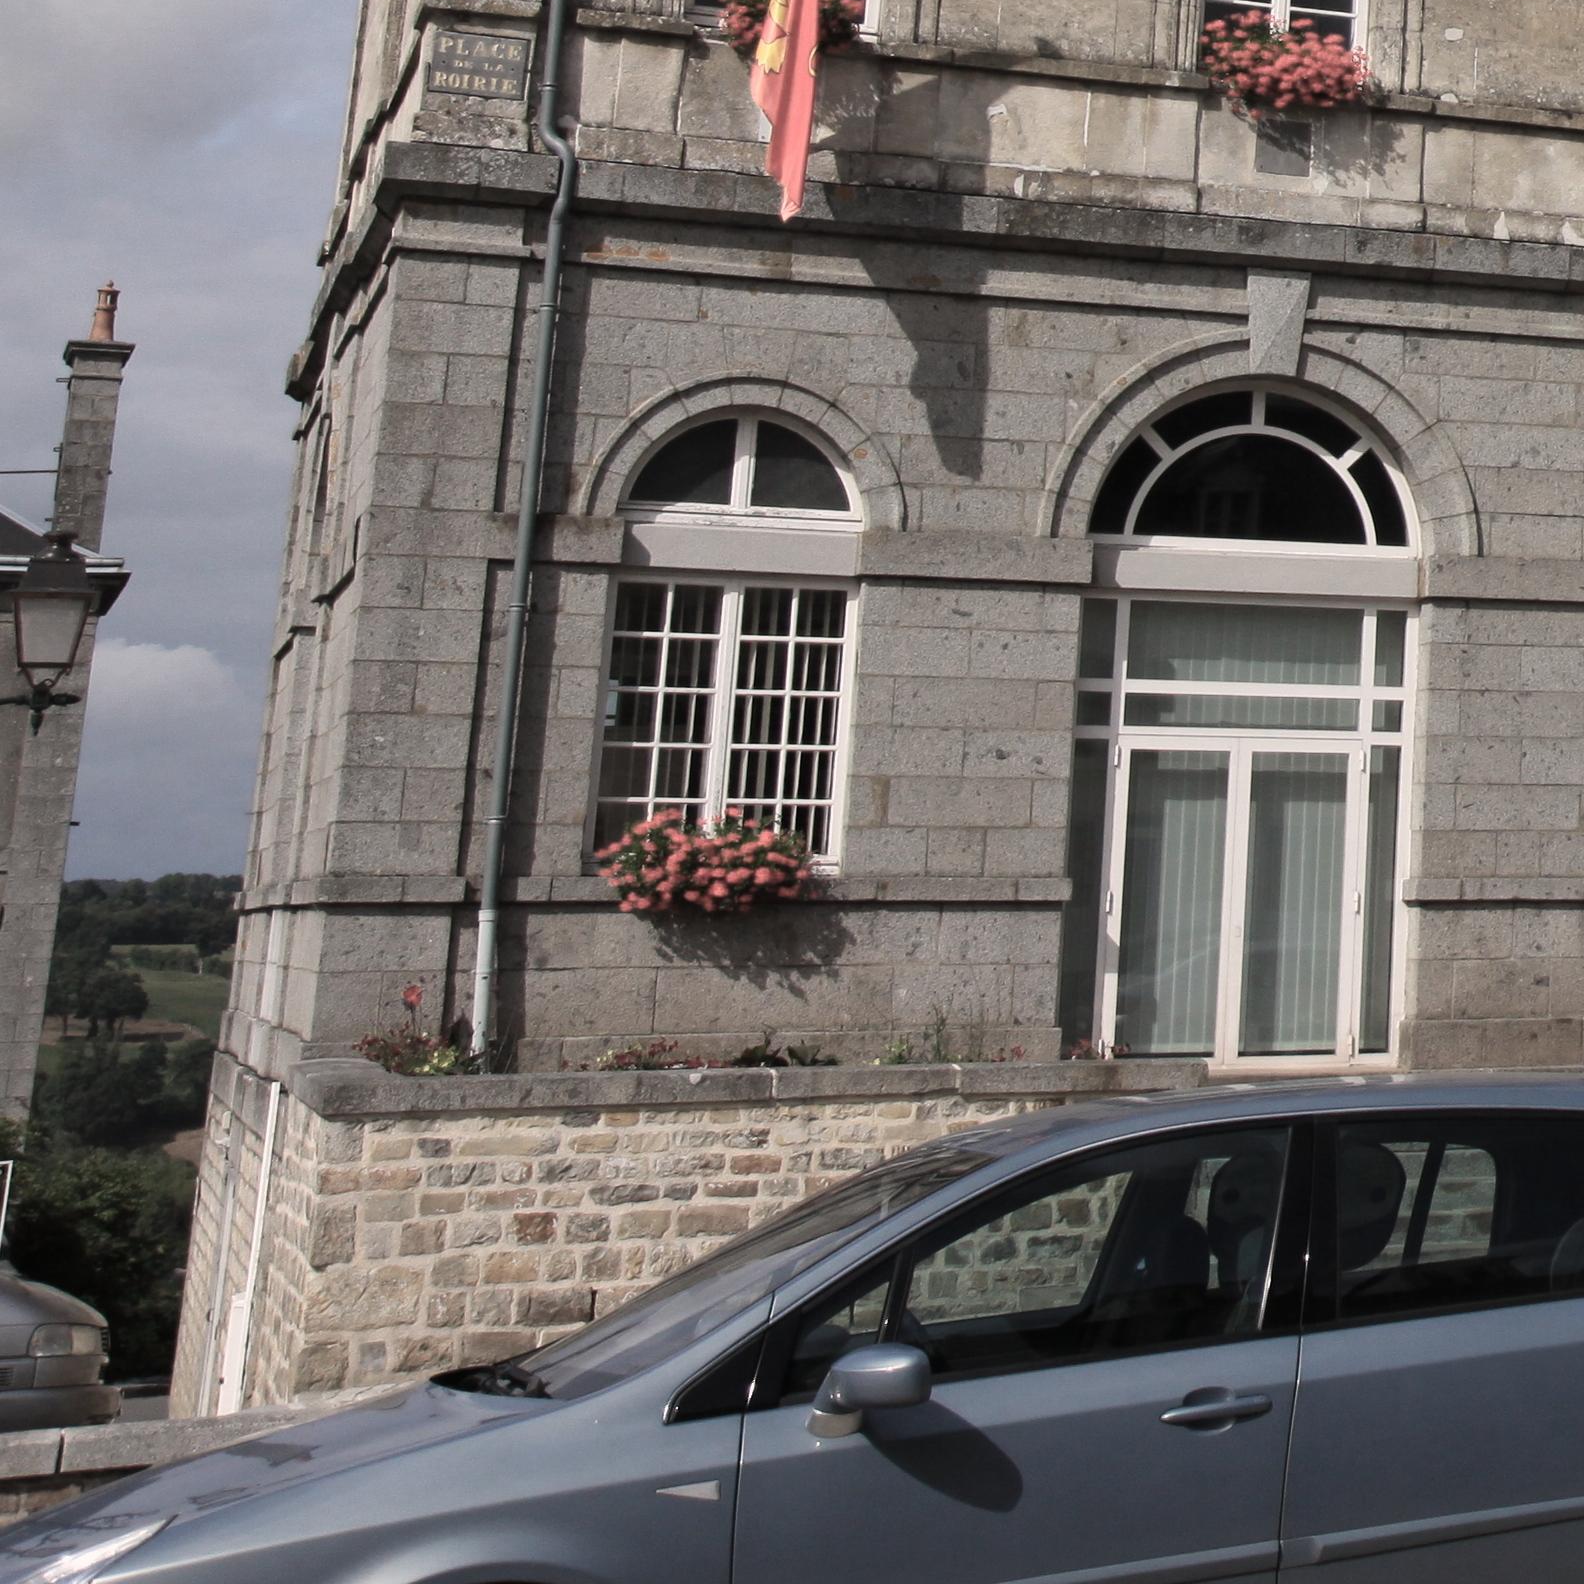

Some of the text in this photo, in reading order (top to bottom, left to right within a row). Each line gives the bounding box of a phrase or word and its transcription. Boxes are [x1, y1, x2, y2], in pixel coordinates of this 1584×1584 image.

[439, 37, 522, 61] PLACE
[453, 59, 505, 72] DE LA
[434, 72, 517, 94] ROIRIE
